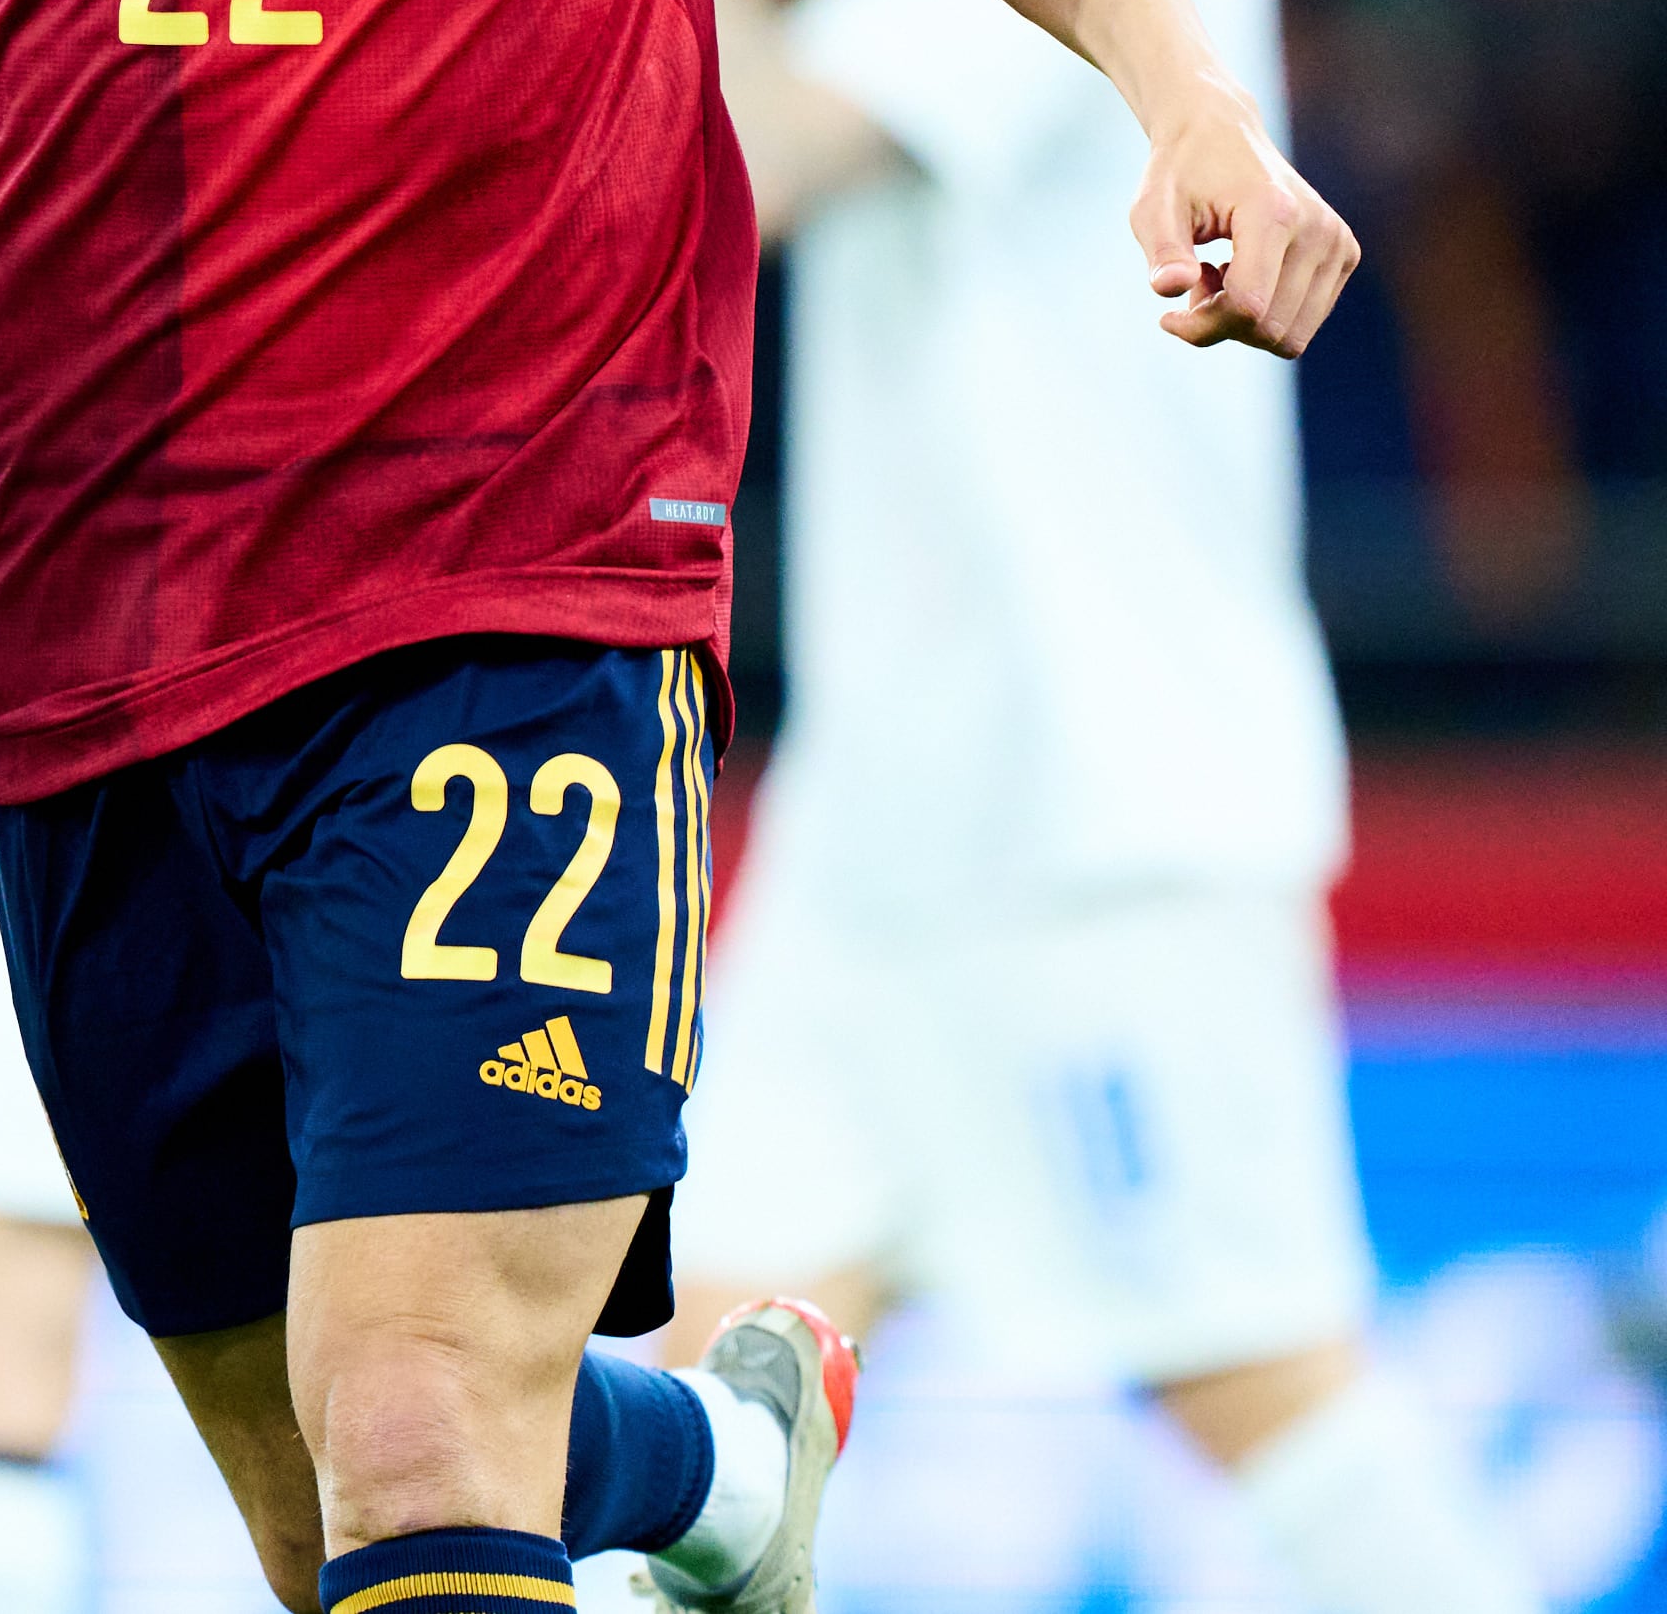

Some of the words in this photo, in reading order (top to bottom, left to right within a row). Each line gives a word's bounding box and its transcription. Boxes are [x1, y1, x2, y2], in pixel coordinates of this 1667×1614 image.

[665, 503, 716, 522] HEAT.RDY
[402, 744, 621, 994] 22
[479, 1060, 602, 1111] adidas
